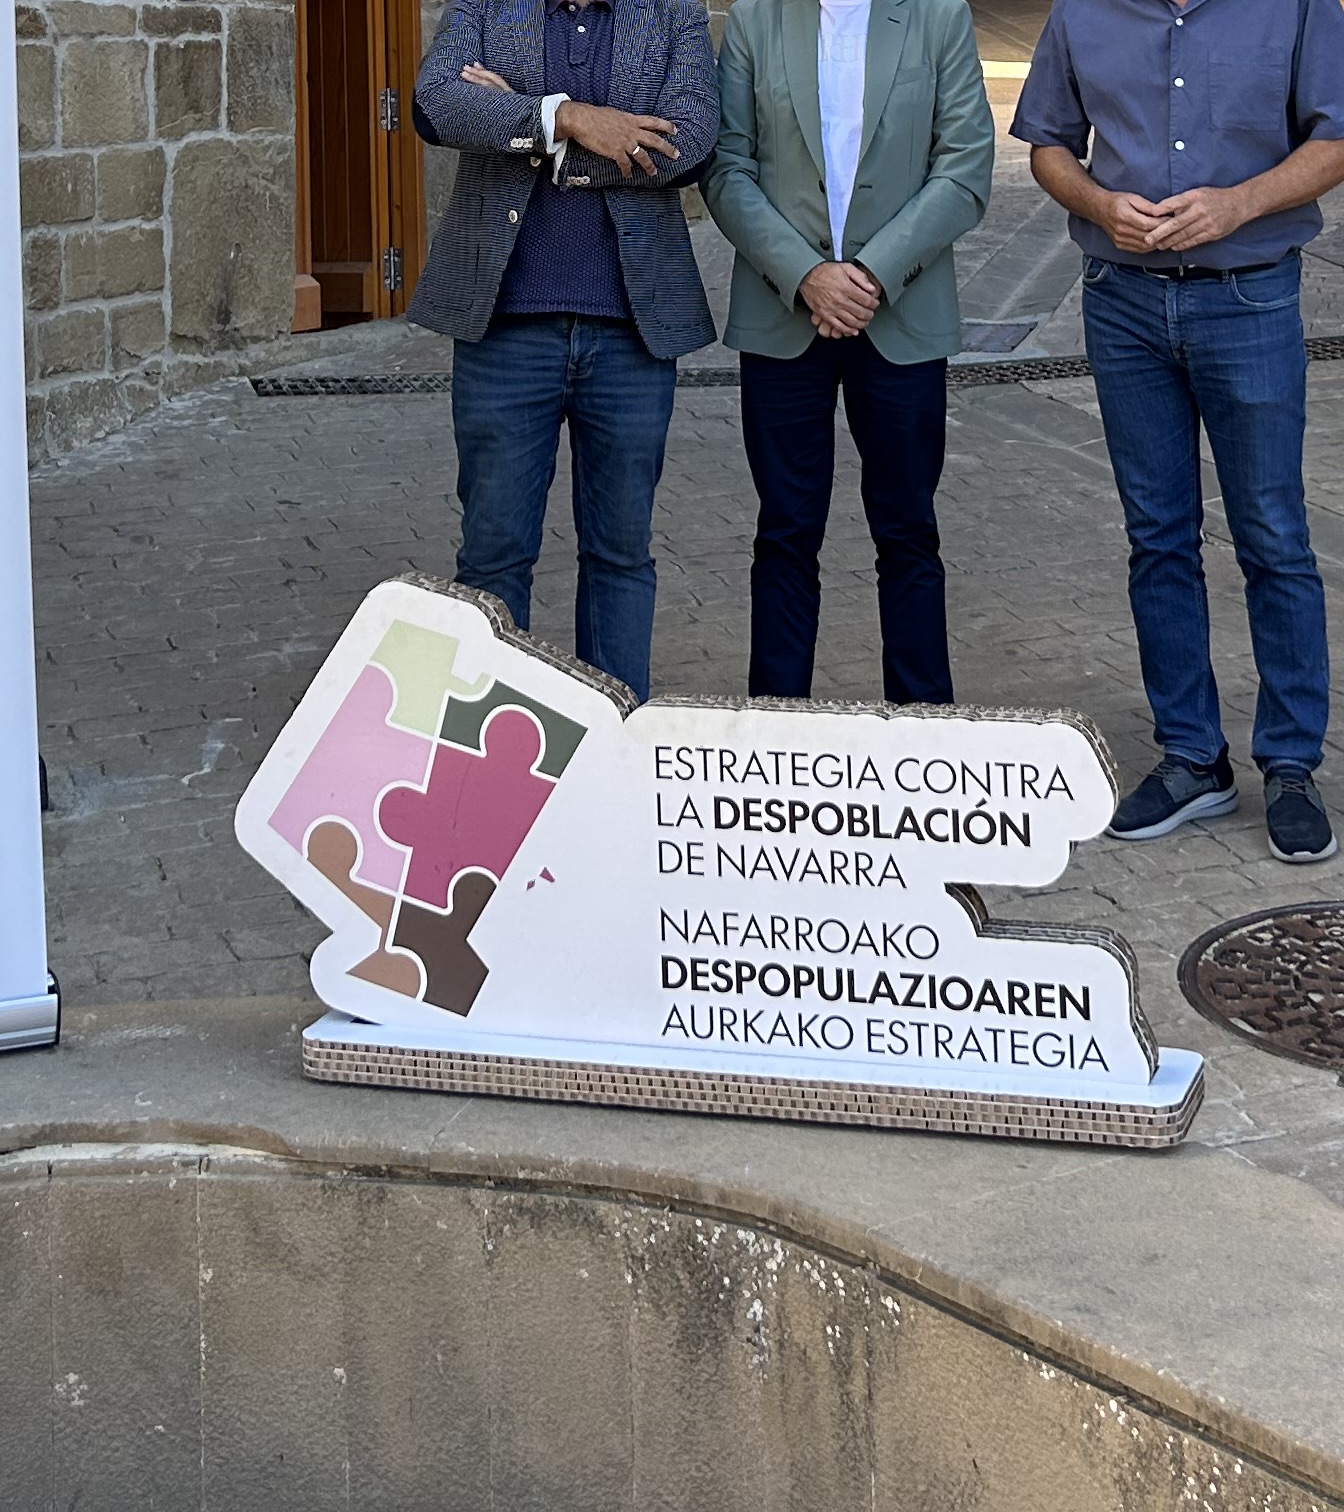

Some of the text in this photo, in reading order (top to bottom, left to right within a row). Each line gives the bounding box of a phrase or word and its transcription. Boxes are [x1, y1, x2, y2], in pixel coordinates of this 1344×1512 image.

[655, 745, 1074, 801] ESTRATEGIA CONTRA
[656, 792, 1031, 848] LA DESPOBLACIÓN
[658, 840, 907, 889] DE NAVARRA
[660, 907, 940, 960] NAFARROAKO
[661, 955, 1091, 1021] DESPOPULAZIOAREN
[662, 1003, 1110, 1072] AURKAKO ESTRATEGIA
